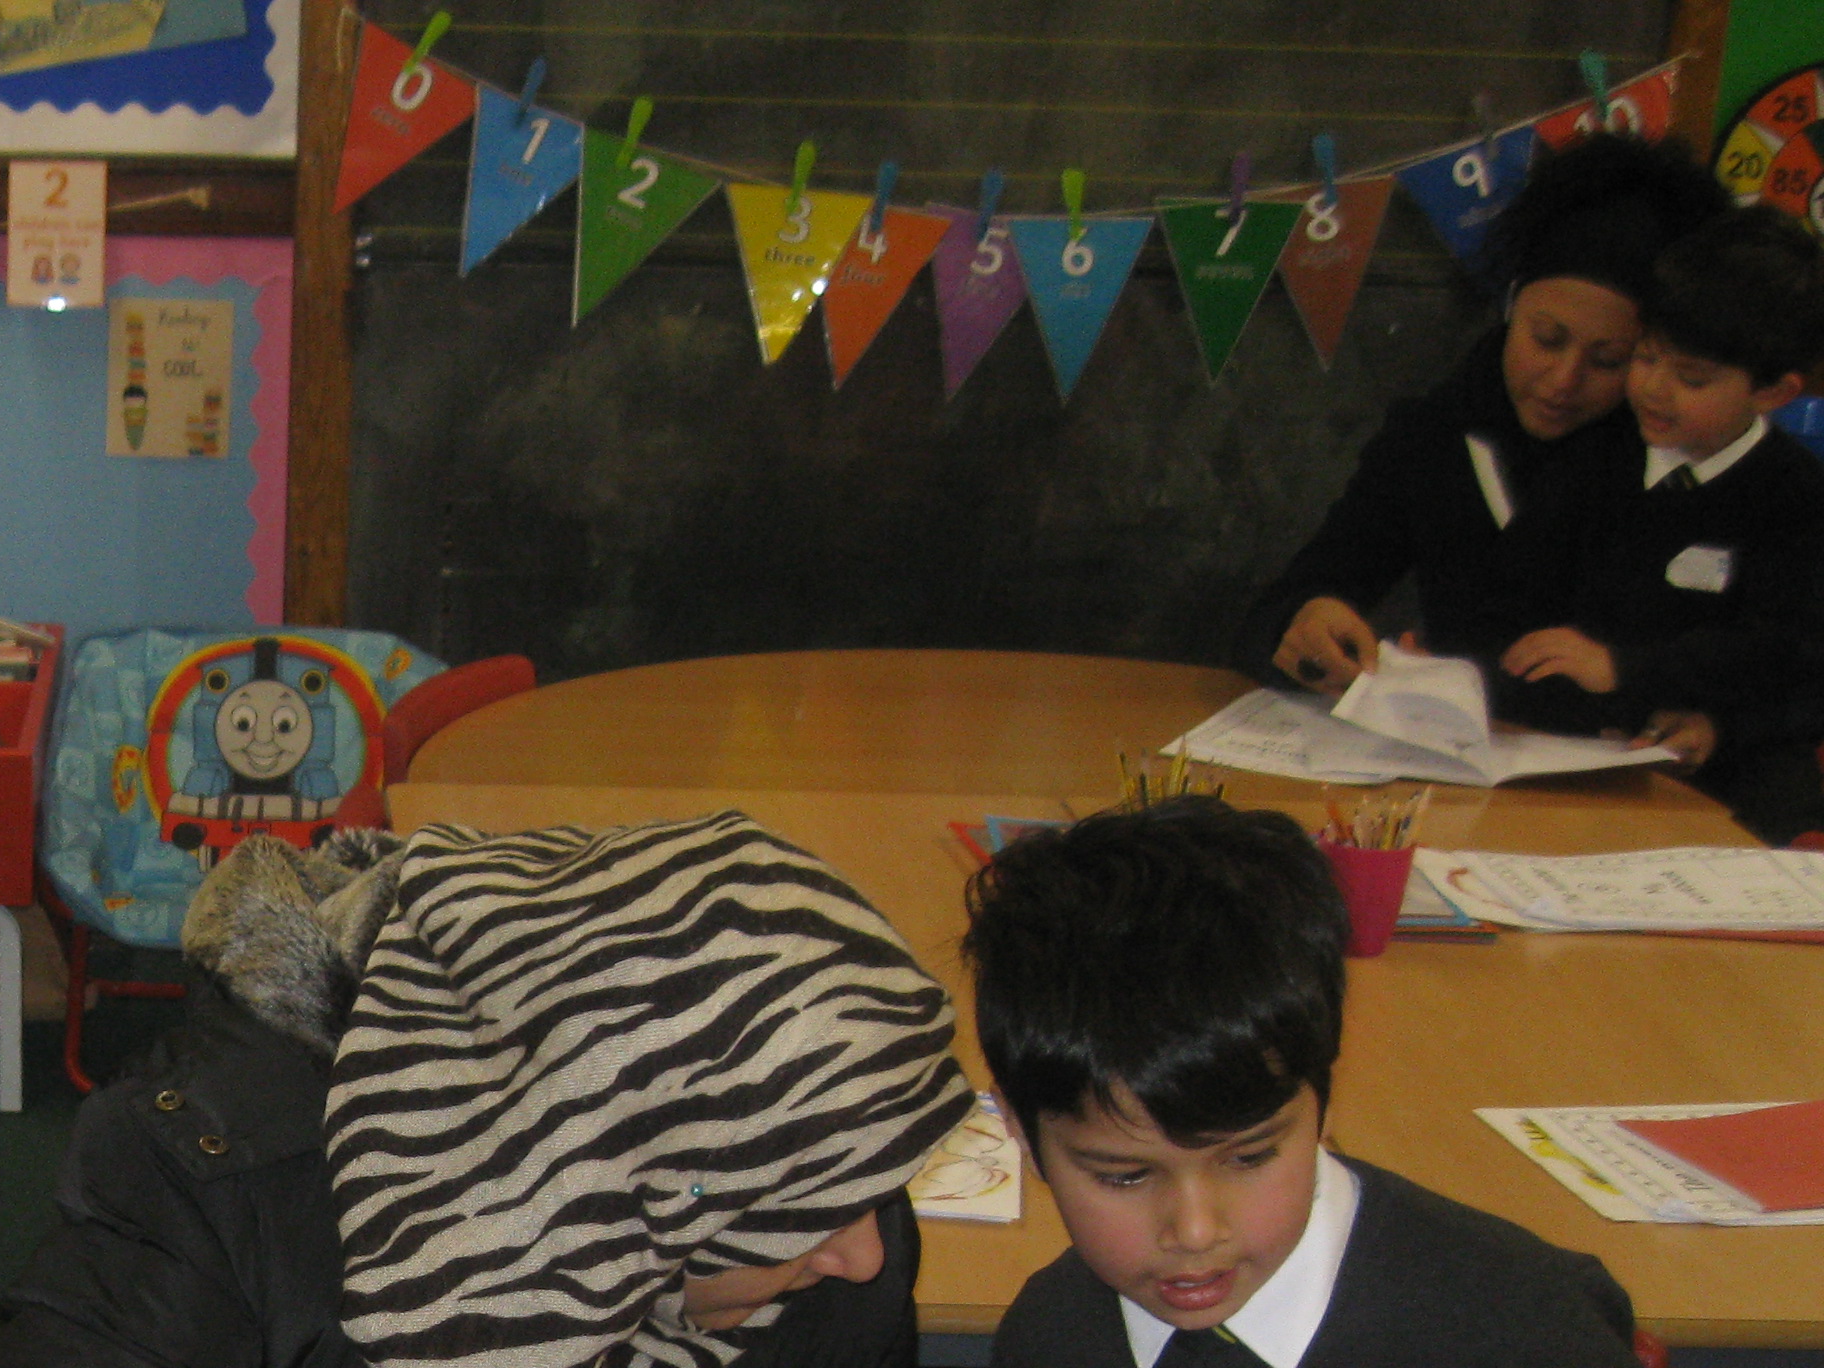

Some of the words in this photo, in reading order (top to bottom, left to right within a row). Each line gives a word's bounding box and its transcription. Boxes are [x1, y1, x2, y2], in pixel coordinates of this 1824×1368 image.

[391, 63, 433, 112] 0
[1773, 95, 1808, 122] 25
[521, 118, 551, 165] 1
[1727, 151, 1763, 179] 20
[44, 169, 68, 208] 2
[617, 157, 660, 210] 2
[1453, 151, 1489, 197] 9
[778, 196, 814, 245] 3
[857, 214, 889, 265] 4
[1215, 207, 1247, 257] 7
[1304, 193, 1340, 243] 8
[763, 248, 816, 267] three
[969, 228, 1008, 276] 5
[1061, 226, 1095, 277] 6
